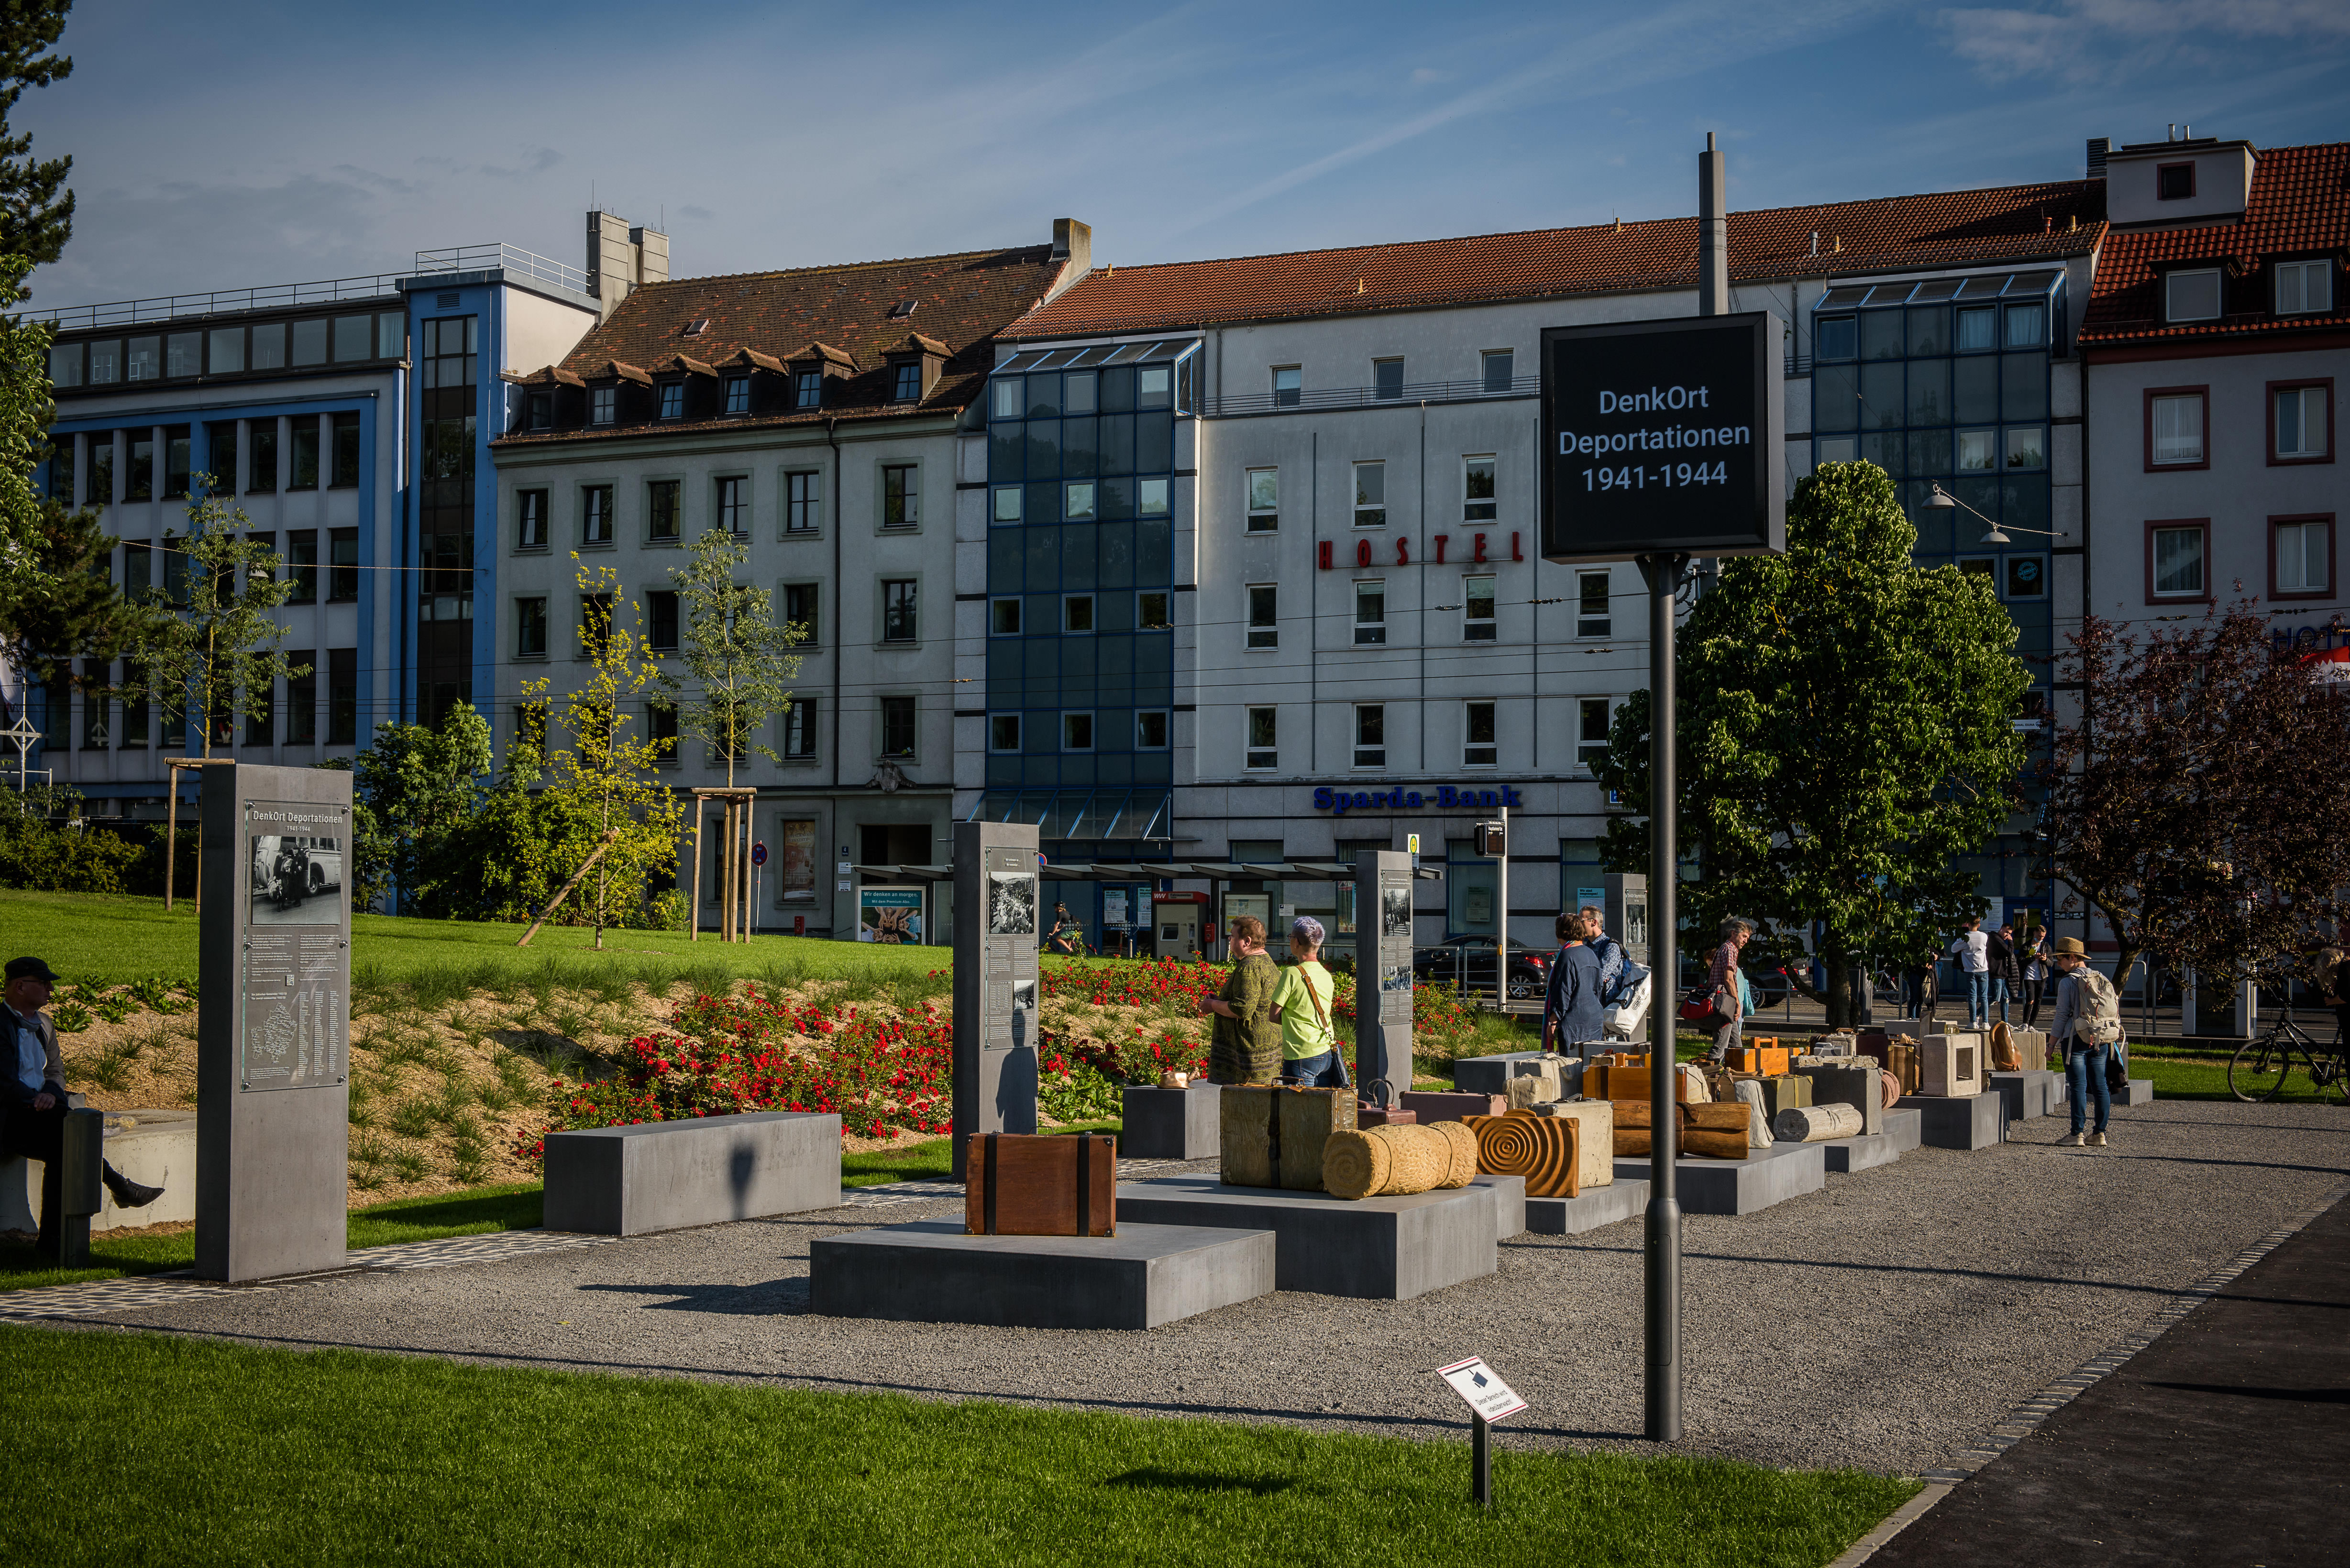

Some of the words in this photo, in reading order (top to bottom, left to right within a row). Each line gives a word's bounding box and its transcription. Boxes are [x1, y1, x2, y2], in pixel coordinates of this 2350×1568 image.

[1600, 386, 1709, 414] DenkOrt
[1559, 424, 1750, 459] Deportationen
[1582, 461, 1727, 492] 1941-1944
[1318, 531, 1523, 570] HOSTEL
[1313, 785, 1522, 814] Sparda-Bank
[254, 811, 286, 821] DenkOrt
[288, 812, 342, 824] Deportationen
[1485, 1392, 1500, 1401] Bereich
